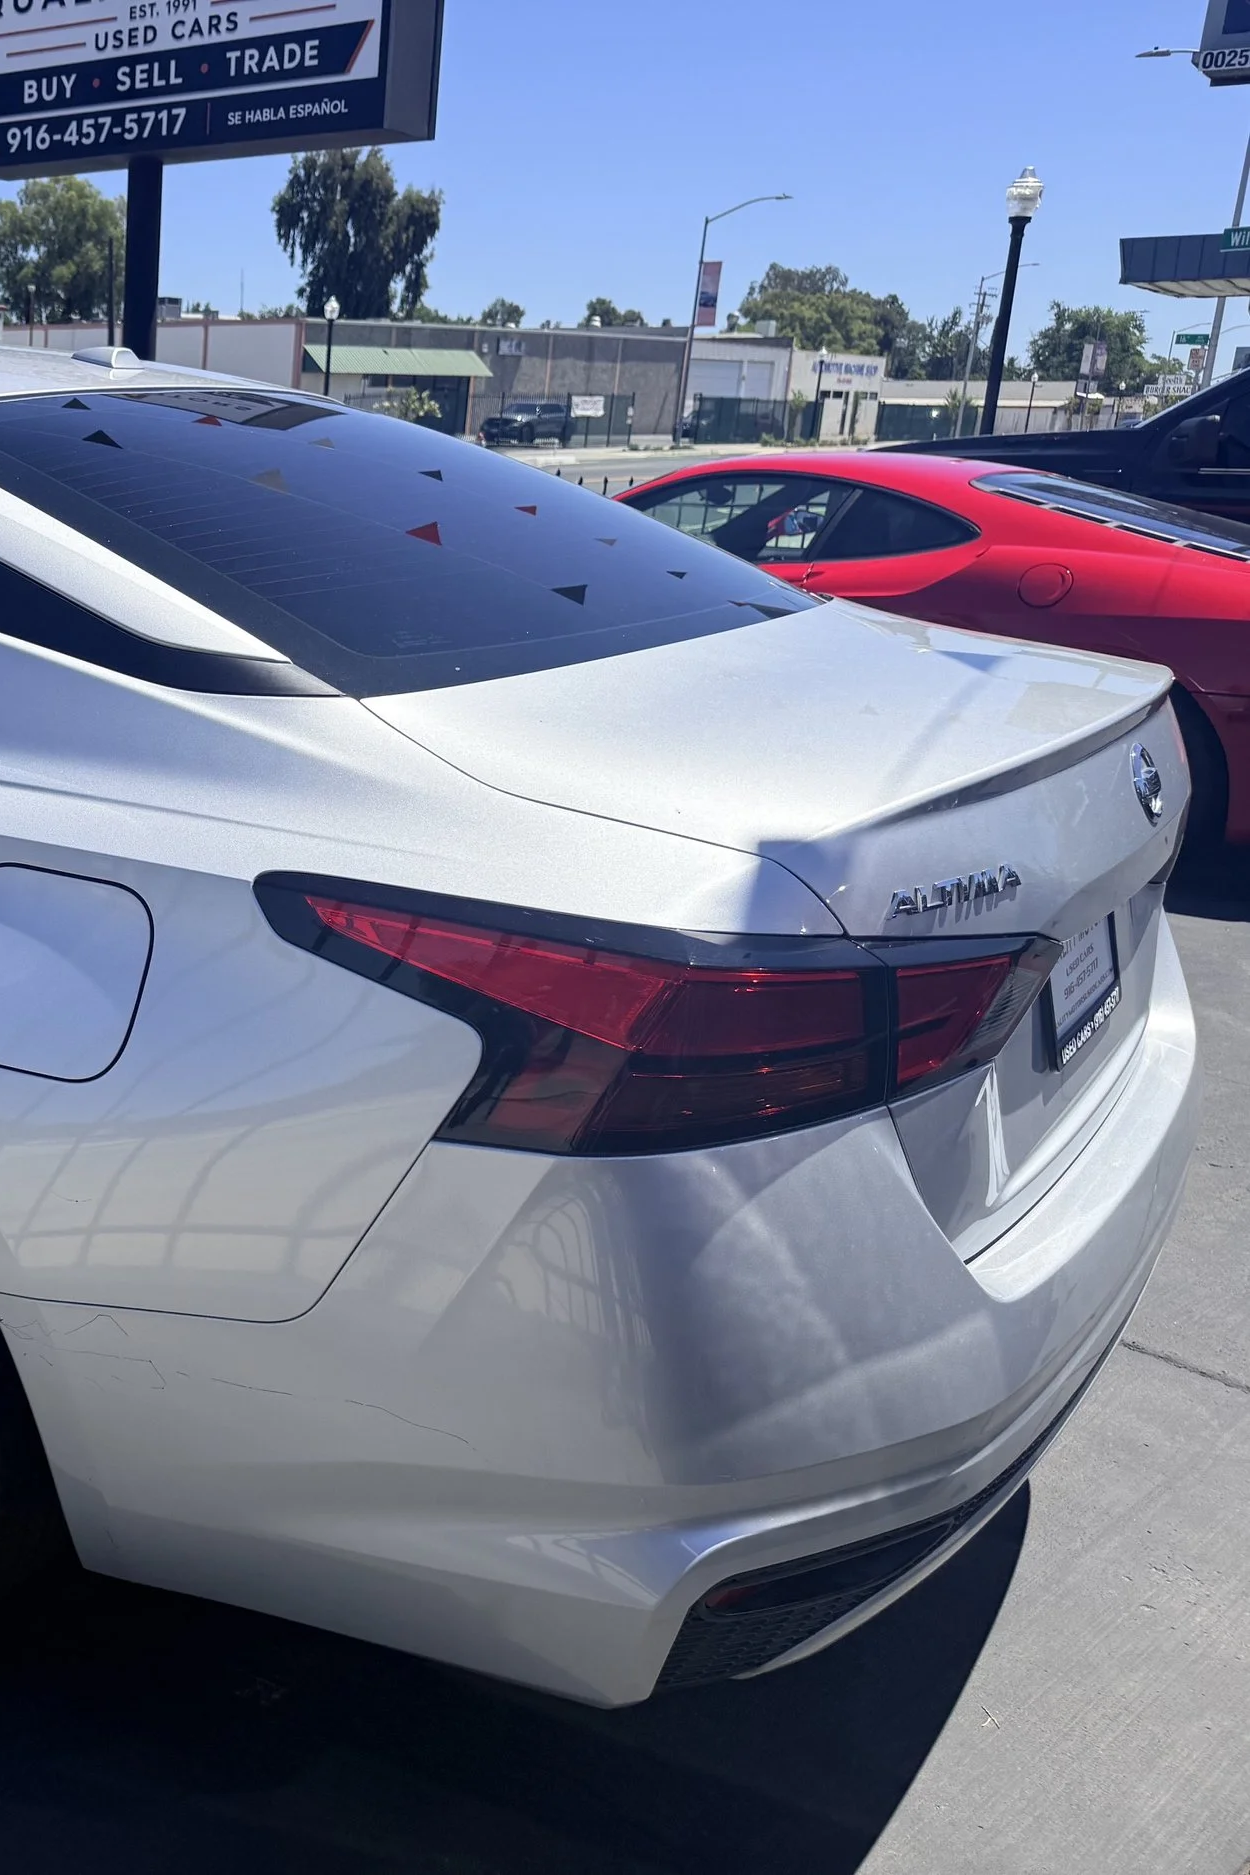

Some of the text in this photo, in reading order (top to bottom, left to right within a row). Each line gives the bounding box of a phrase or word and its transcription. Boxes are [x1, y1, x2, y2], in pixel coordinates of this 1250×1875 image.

[94, 12, 238, 51] USED CARS
[129, 0, 197, 20] EST. 1991
[23, 39, 320, 104] BUY SELL TRADE
[6, 98, 348, 153] 916-457-5717 SE HABLA ESPAÑOL
[887, 863, 1022, 919] ALTIMA
[1079, 943, 1094, 962] CARS
[1061, 1037, 1077, 1065] USED
[1076, 1021, 1092, 1049] CARS
